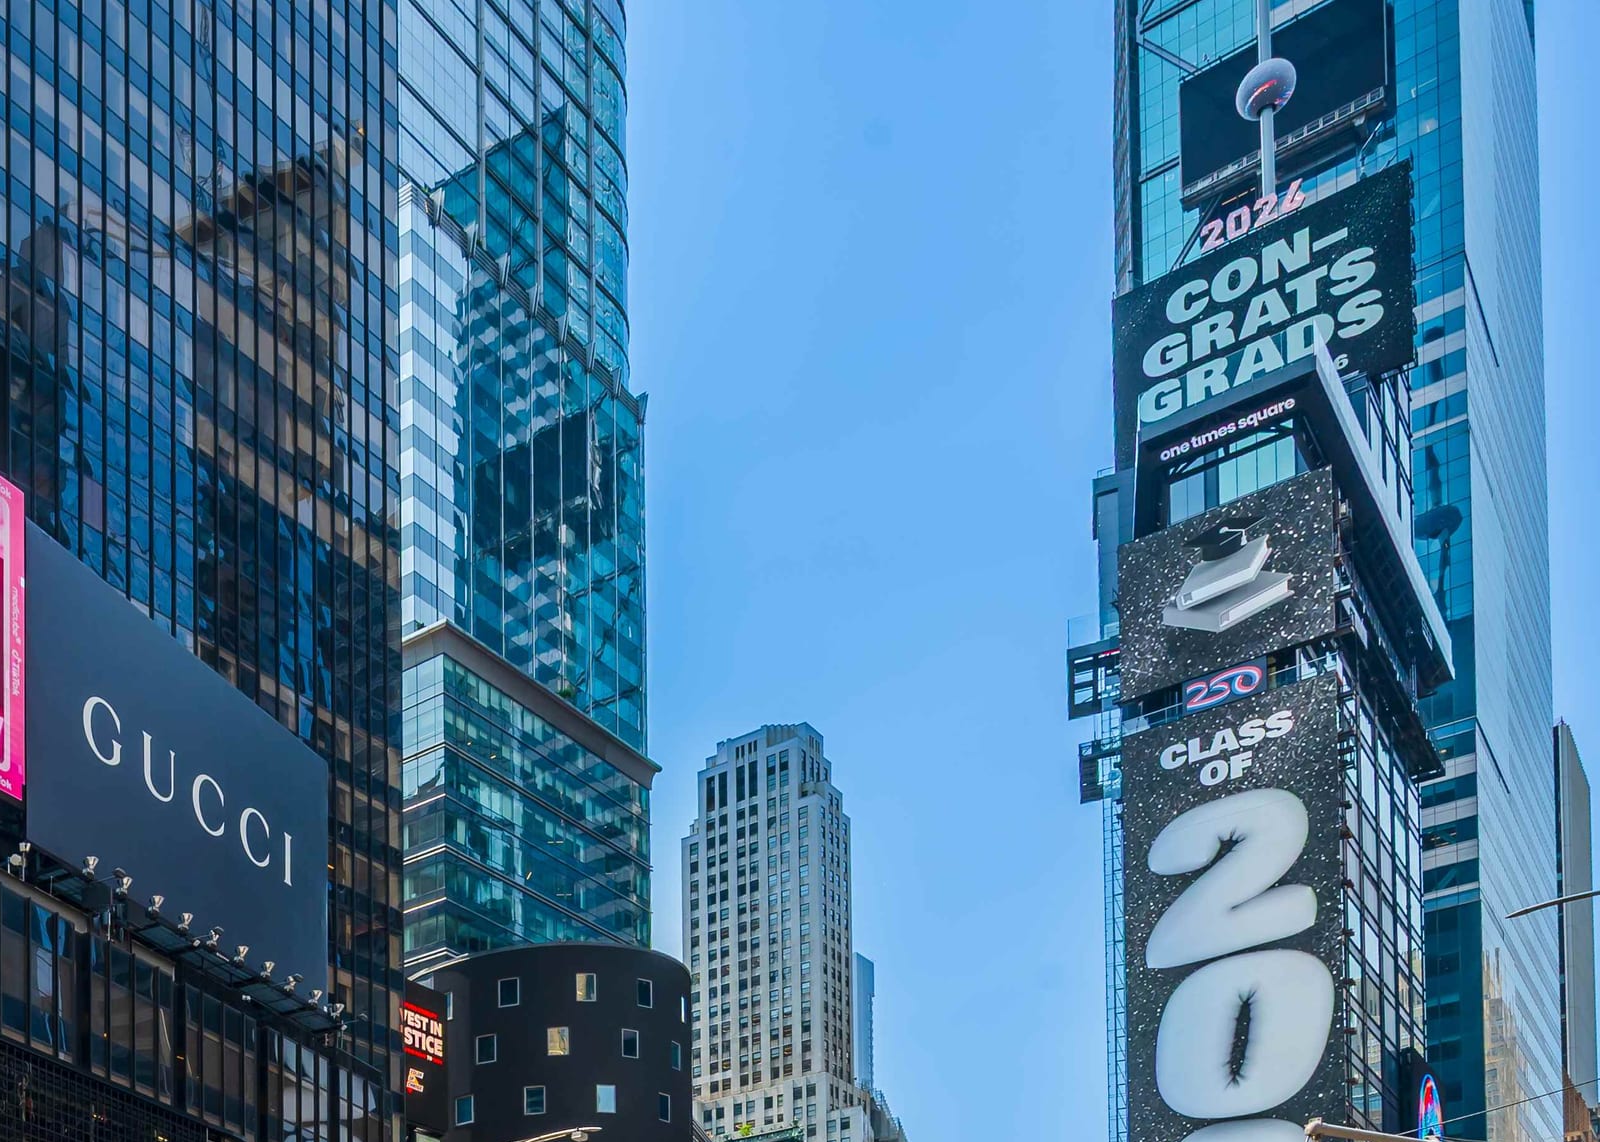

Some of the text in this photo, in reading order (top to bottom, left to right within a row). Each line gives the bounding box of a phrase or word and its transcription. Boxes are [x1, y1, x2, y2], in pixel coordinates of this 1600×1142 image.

[1166, 226, 1349, 324] CON-
[1142, 247, 1376, 377] GRATS
[1139, 289, 1385, 423] GRADS
[1160, 398, 1296, 461] one times square
[1186, 665, 1263, 712] 250
[1160, 710, 1294, 770] CLASS
[1200, 751, 1253, 786] OF
[82, 696, 293, 887] GUCCI
[430, 1020, 443, 1038] IN
